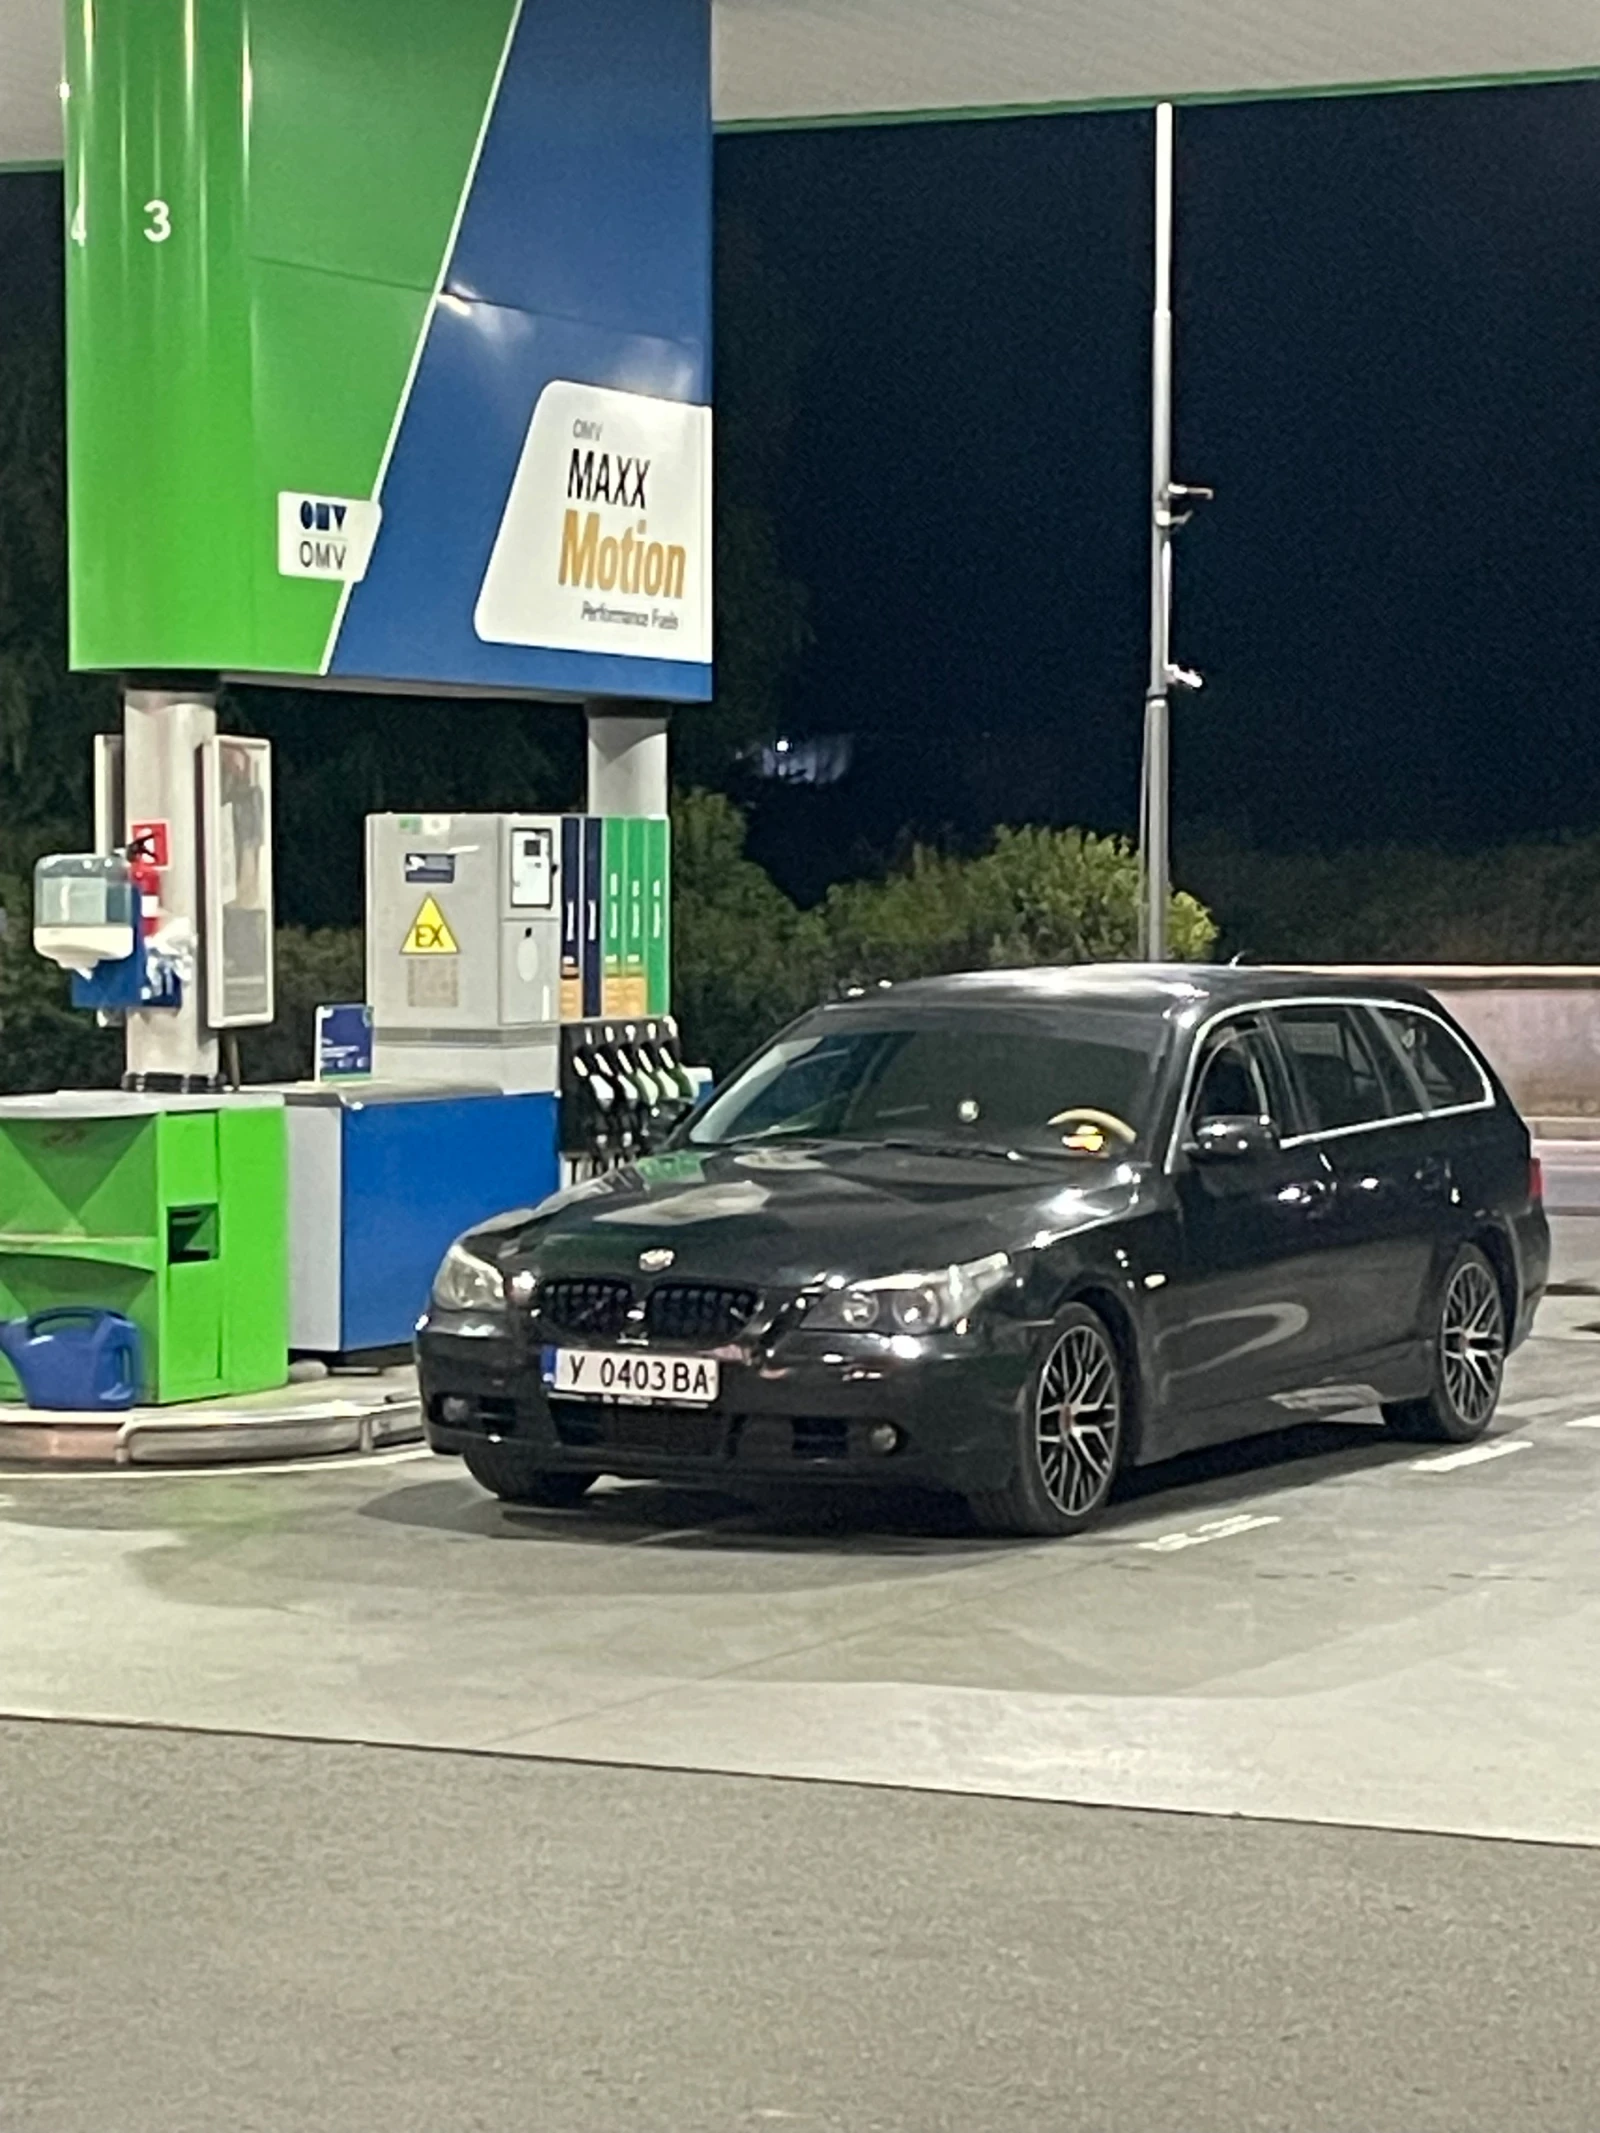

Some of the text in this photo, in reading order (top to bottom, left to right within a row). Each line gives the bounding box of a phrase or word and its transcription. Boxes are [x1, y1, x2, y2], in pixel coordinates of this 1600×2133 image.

[143, 199, 171, 242] 3
[573, 418, 602, 441] OMV
[566, 448, 650, 510] MAXX
[300, 540, 347, 570] OMV
[558, 508, 686, 599] Motion
[415, 924, 445, 948] EX
